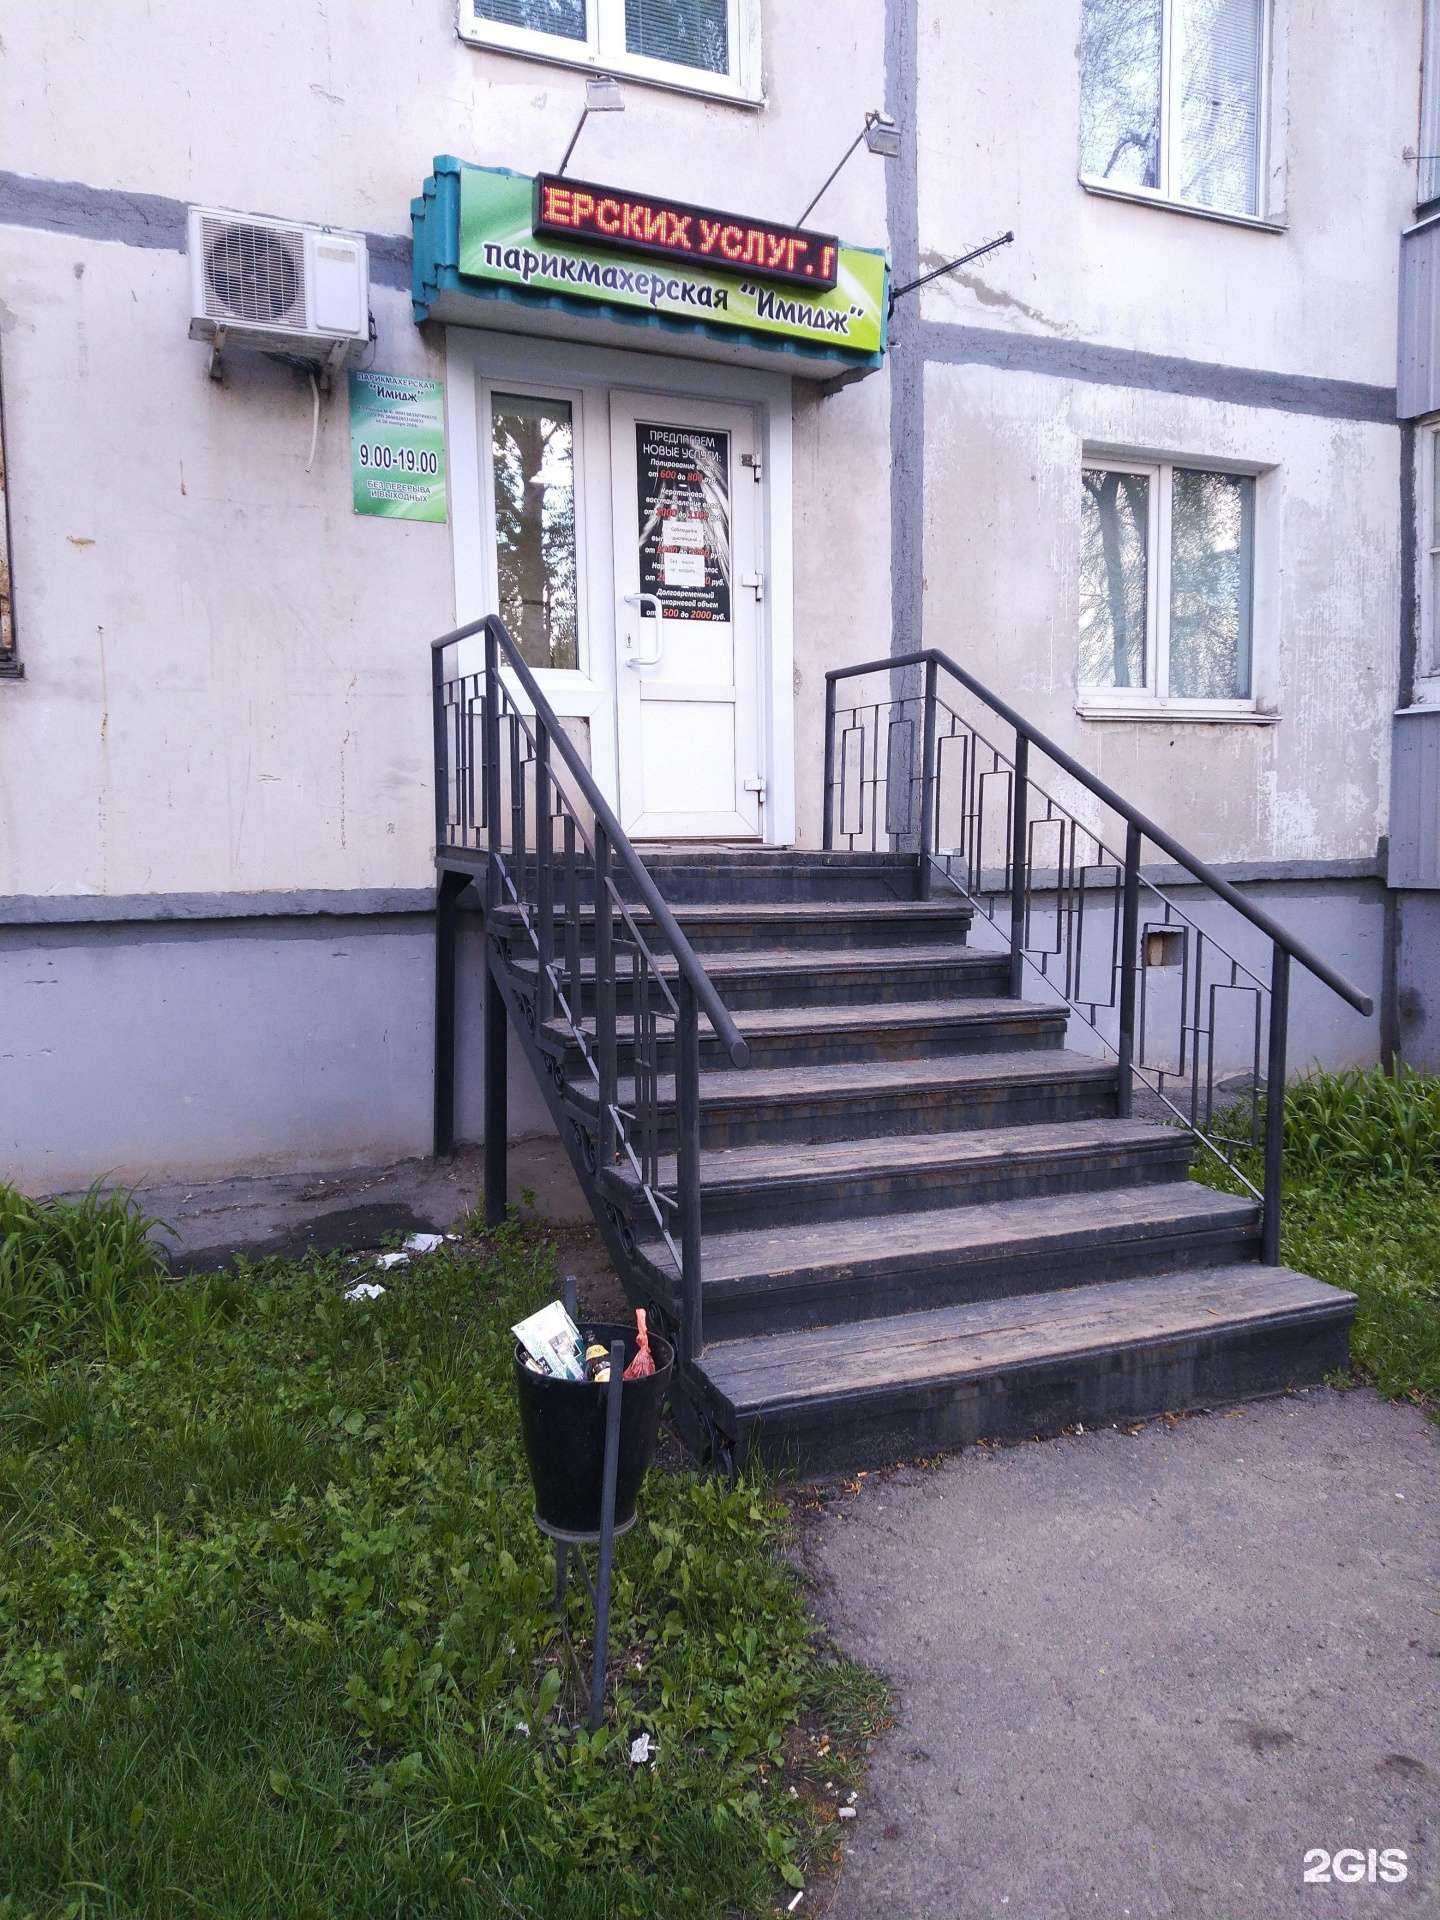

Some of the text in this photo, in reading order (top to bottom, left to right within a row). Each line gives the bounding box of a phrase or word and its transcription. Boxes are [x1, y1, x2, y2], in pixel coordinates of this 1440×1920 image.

[483, 243, 728, 309] парикмахерская
[356, 372, 436, 391] ПАРИКМАХЕРСКАЯ
[649, 430, 715, 447] ПРЕДЛАГАЕМ
[643, 443, 680, 458] НОВЫЕ
[360, 444, 437, 474] 9.00-19.00
[650, 458, 695, 470] Полирование
[648, 470, 659, 478] от
[677, 472, 686, 481] до
[367, 480, 431, 494] БЕЗ ПЕРЕРЫВА
[379, 491, 428, 503] ВЫХОДНЫХ
[704, 566, 719, 574] олос
[711, 579, 725, 587] руб.
[656, 588, 715, 599] Долговременный
[661, 599, 696, 609] икорневой
[680, 611, 689, 619] до
[690, 609, 711, 619] 2000
[711, 613, 726, 621] руб.
